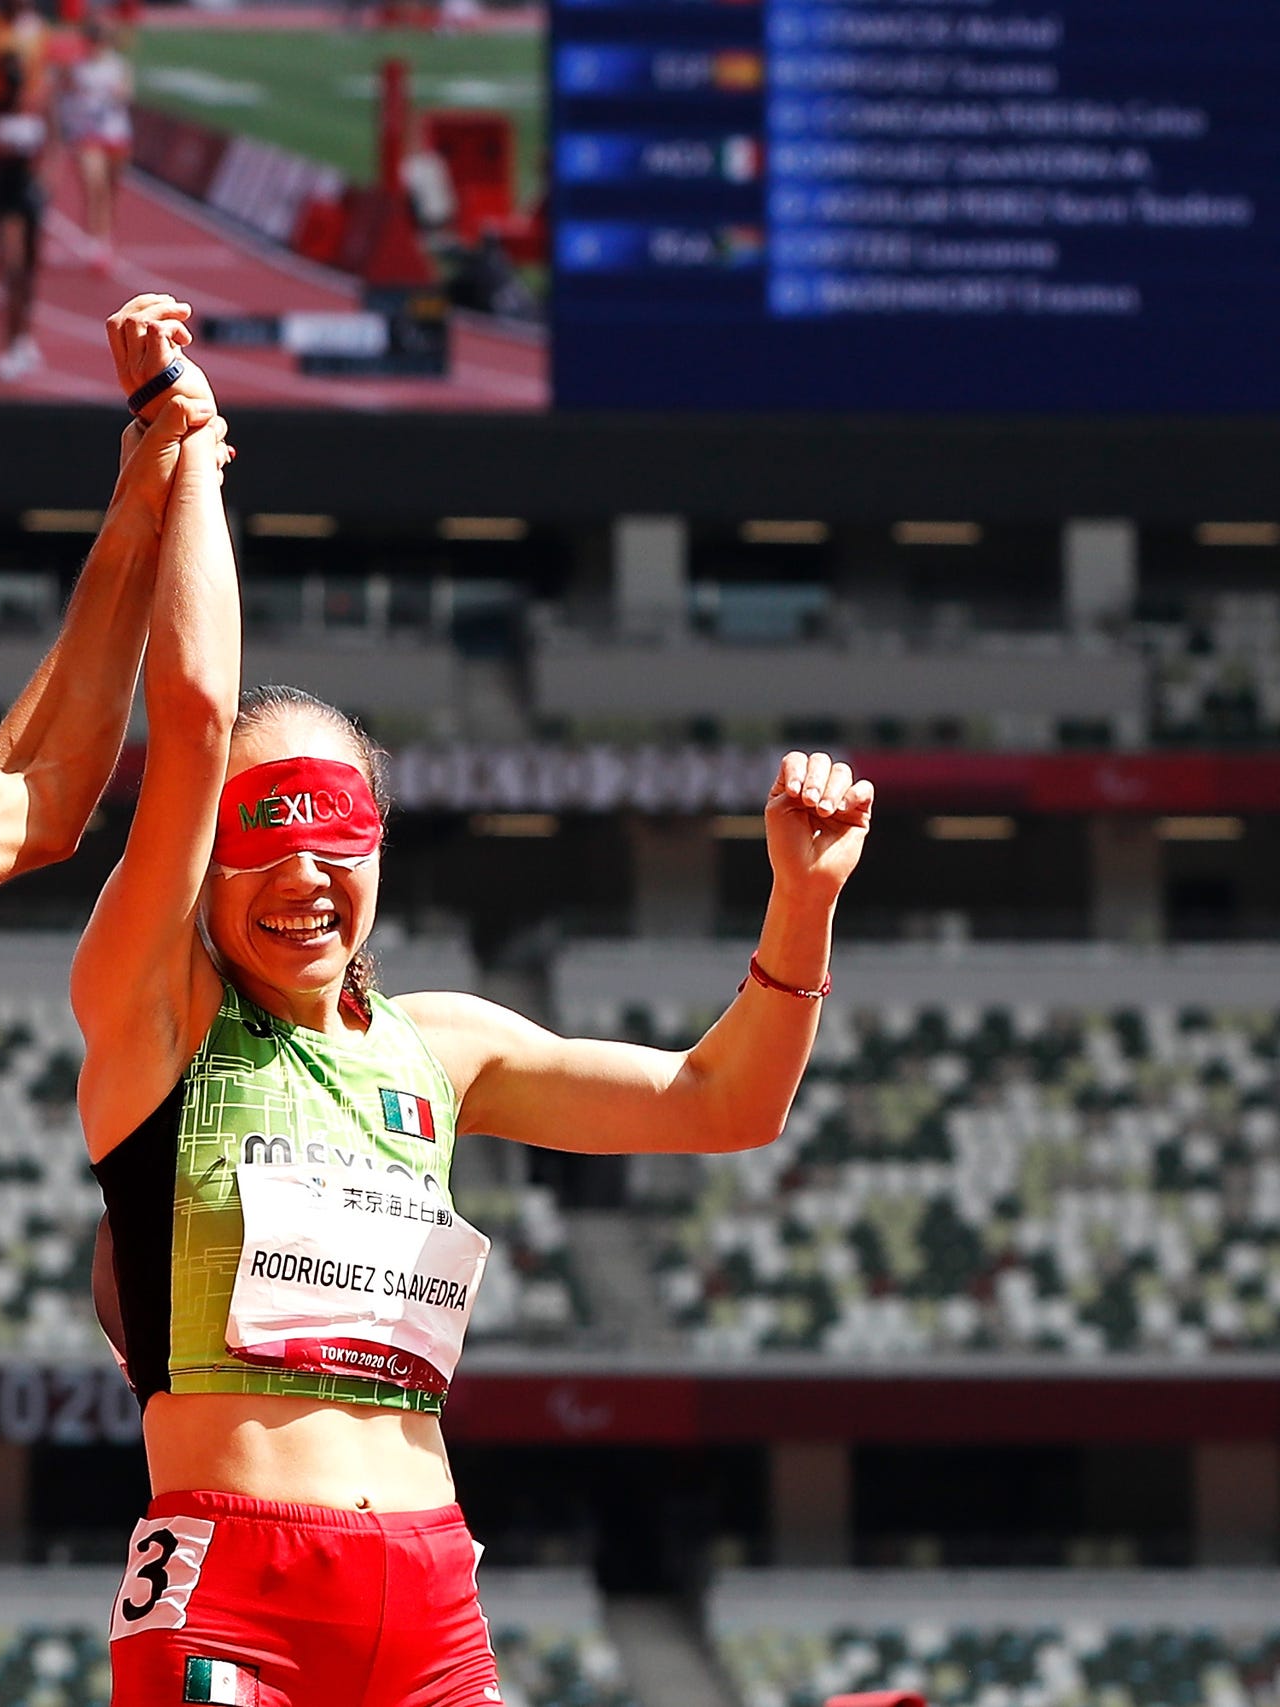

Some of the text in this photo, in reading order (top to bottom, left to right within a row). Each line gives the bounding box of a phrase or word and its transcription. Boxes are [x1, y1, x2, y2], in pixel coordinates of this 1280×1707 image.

[237, 784, 354, 832] MÉXICO
[250, 1250, 468, 1312] RODRIGUEZ SAAVEDRA
[320, 1345, 385, 1369] TOKYO 2020
[122, 1527, 179, 1621] 3
